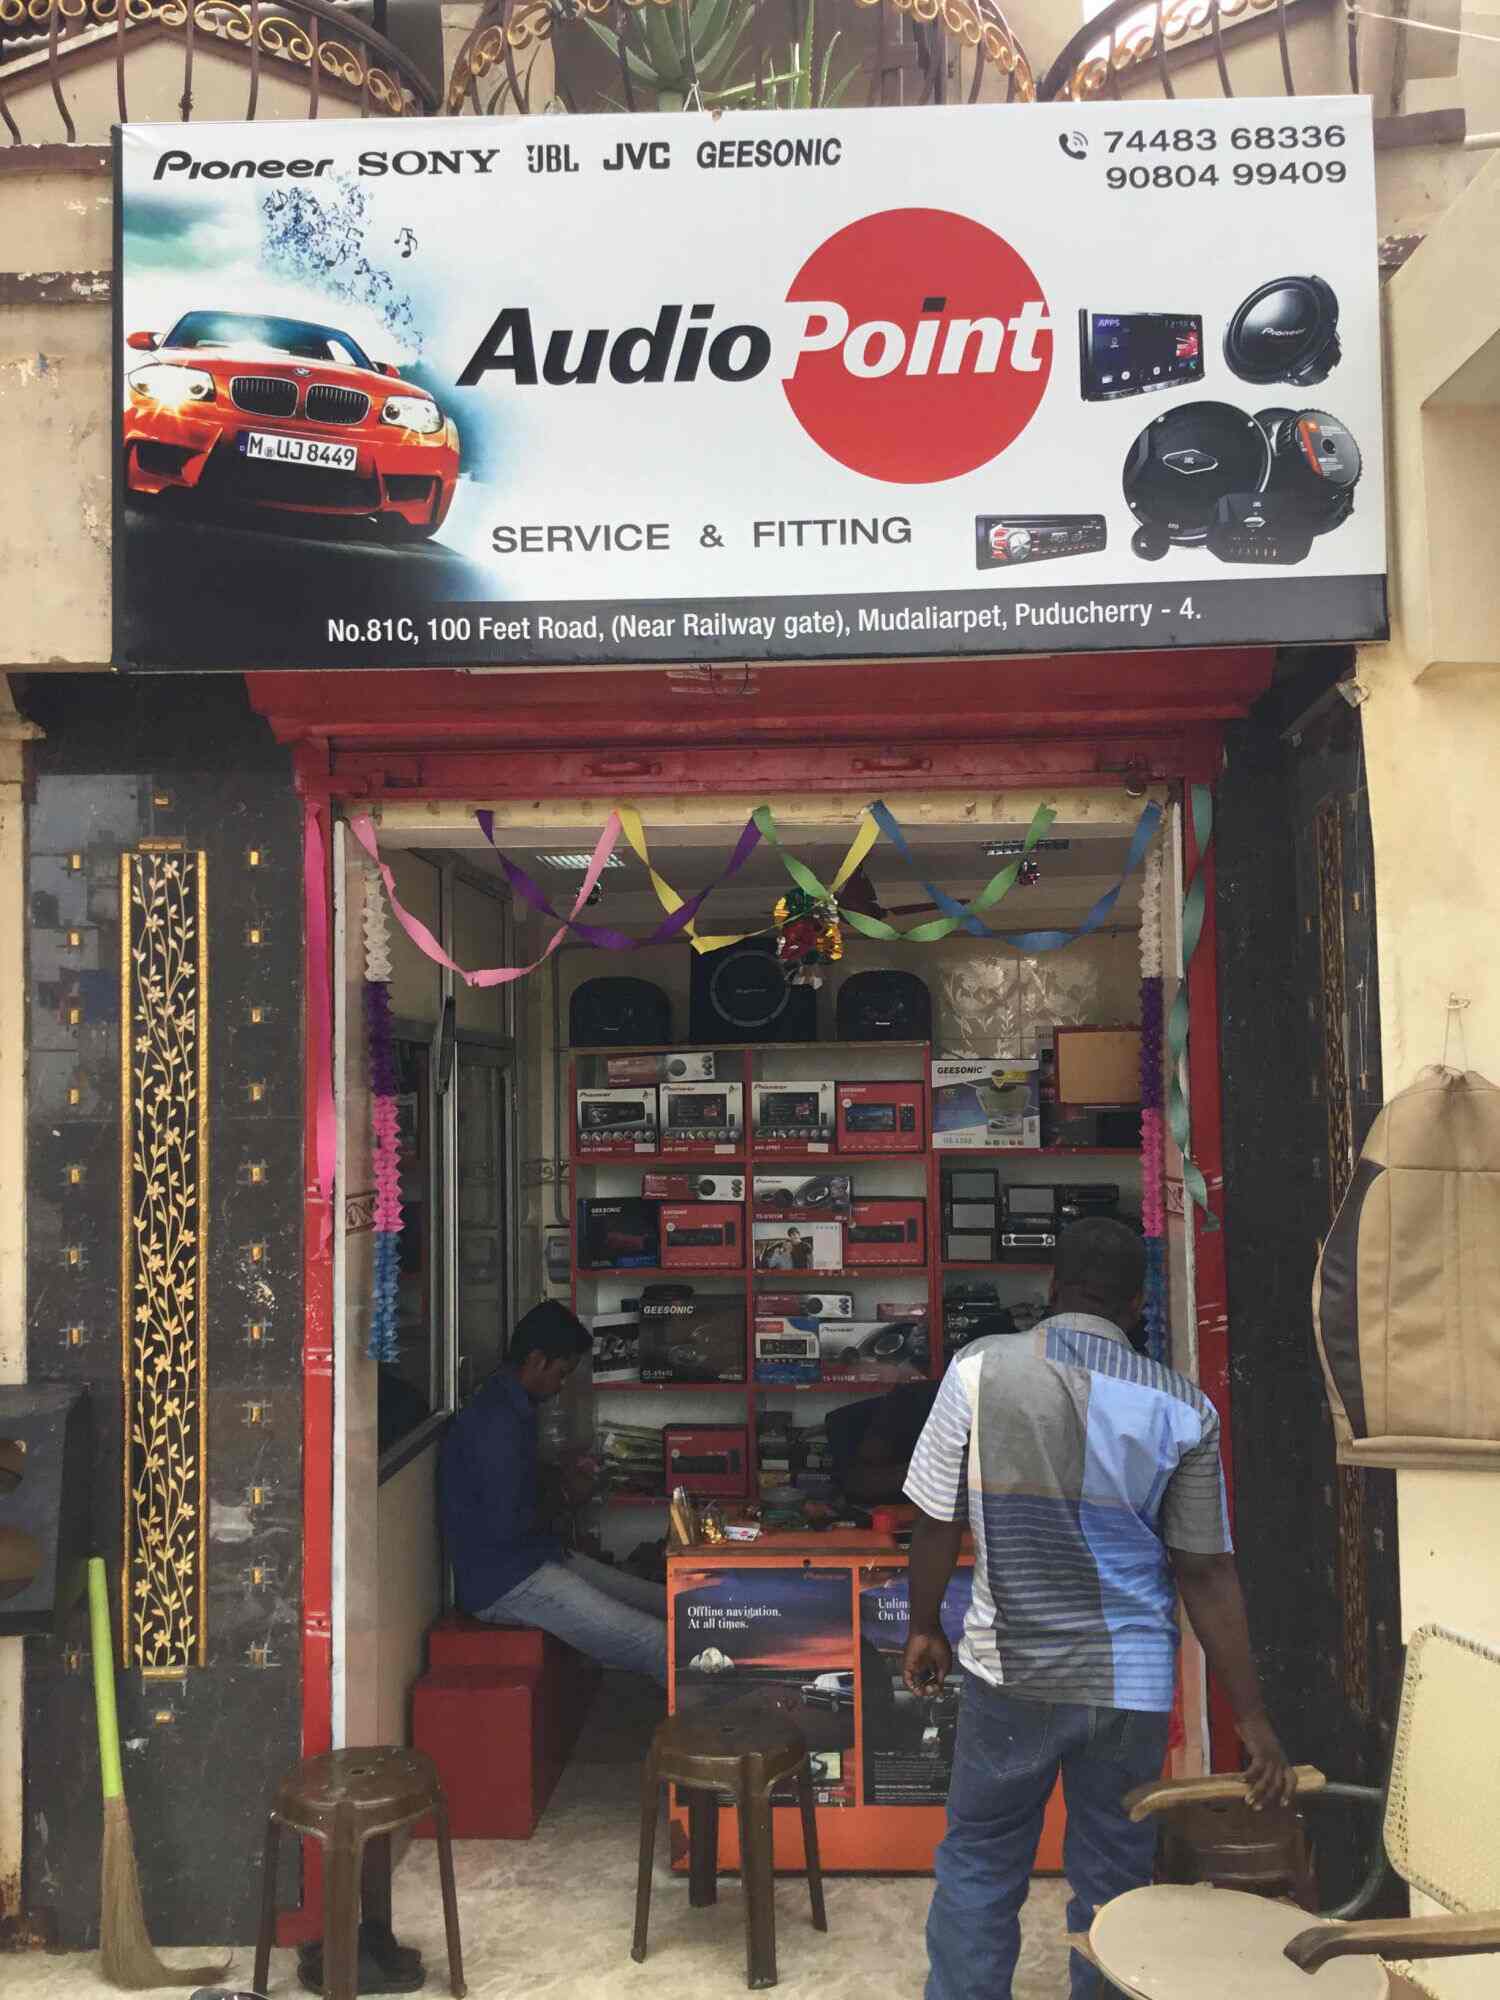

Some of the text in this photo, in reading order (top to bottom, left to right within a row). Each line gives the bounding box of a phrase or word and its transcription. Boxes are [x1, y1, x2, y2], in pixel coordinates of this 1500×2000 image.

[1103, 125, 1346, 153] 74483 68336
[153, 137, 842, 180] Pioneer SONY JBL JVC GEESONIC
[1105, 160, 1347, 190] 90804 99409
[1260, 326, 1306, 337] Pioneer
[456, 297, 1054, 386] Audio Point
[248, 435, 263, 455] M
[492, 516, 912, 554] SERVICE & FITTING
[327, 617, 420, 645] No.81C,
[427, 617, 471, 640] 100
[478, 616, 530, 640] Feet
[537, 614, 604, 643] Road,
[611, 613, 676, 643] (Near
[683, 610, 775, 639] Railway
[784, 608, 850, 639] gate),
[857, 603, 1008, 635] Mudaliarpet,
[1014, 599, 1152, 628] Puducherry
[1178, 596, 1202, 621] 4.
[937, 1066, 983, 1074] GEESONIC
[643, 1304, 696, 1315] GEESONIC
[687, 1604, 782, 1619] Offline navigation.
[878, 1597, 911, 1609] Unlim
[687, 1617, 749, 1629] At all times.
[877, 1610, 894, 1621] On
